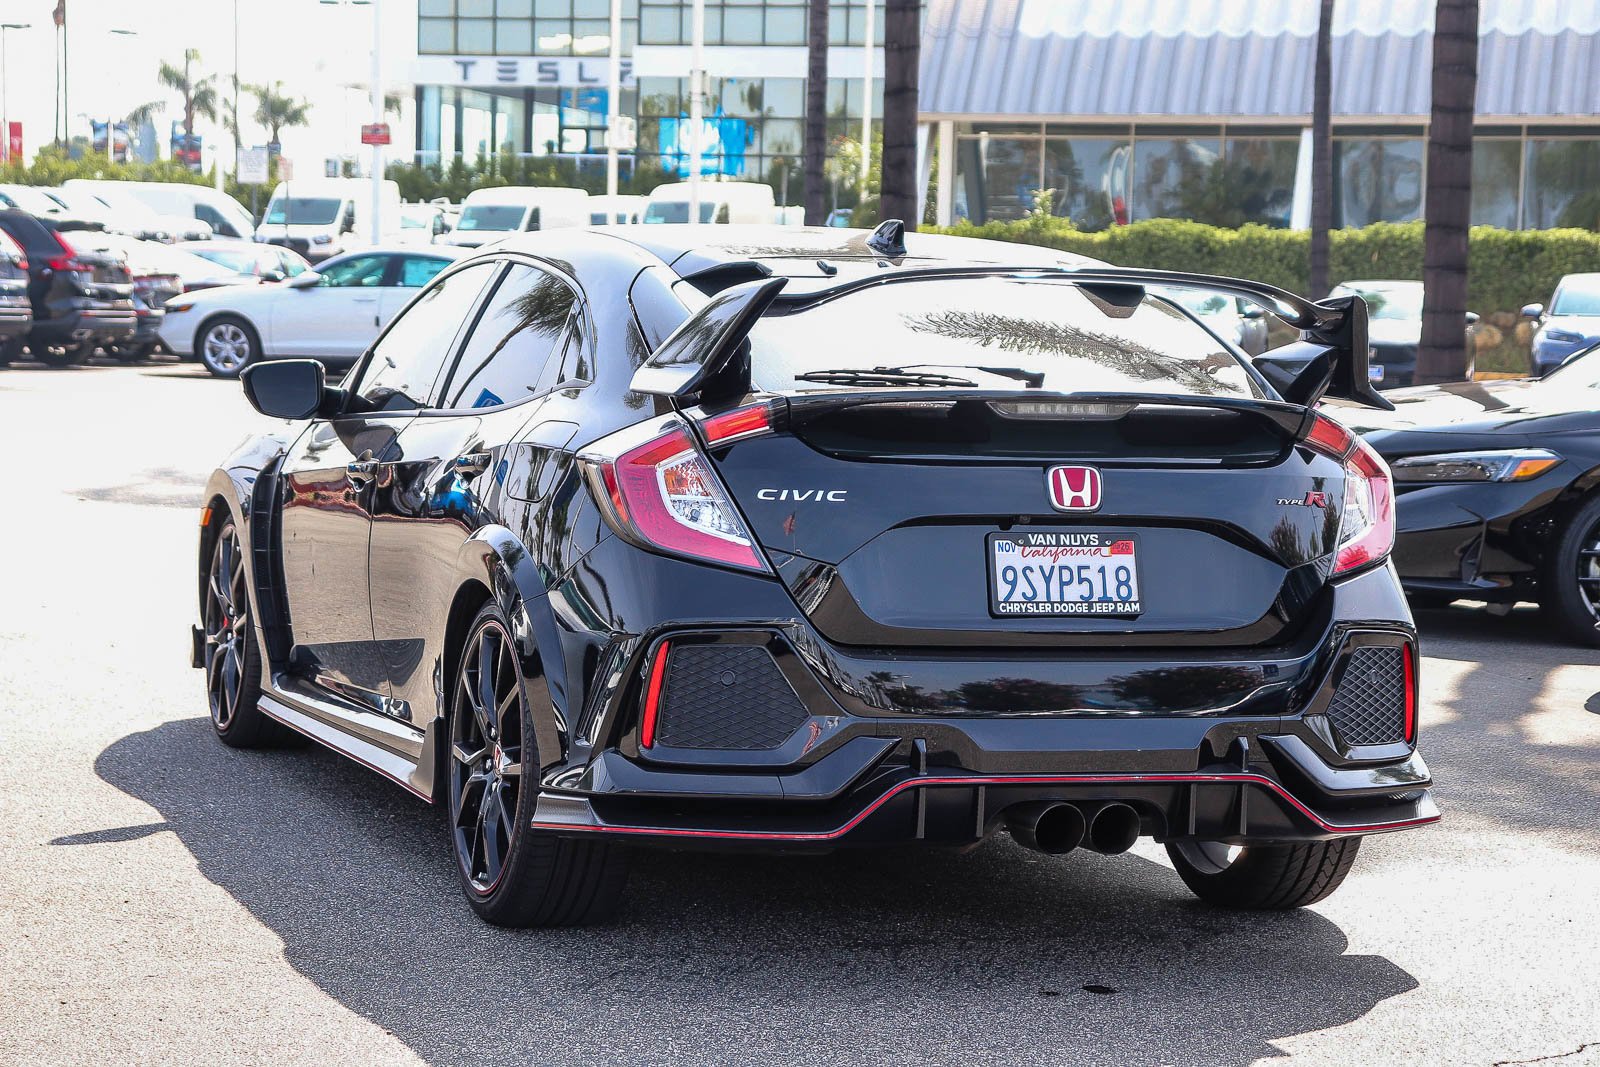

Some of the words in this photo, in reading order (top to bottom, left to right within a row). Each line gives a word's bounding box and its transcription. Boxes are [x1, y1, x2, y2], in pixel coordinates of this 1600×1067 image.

[757, 488, 847, 502] CIVIC
[1277, 498, 1305, 506] TYPE
[1305, 491, 1327, 508] R
[1028, 533, 1056, 546] VAN
[1060, 533, 1099, 546] NUYS
[997, 541, 1017, 553] NOV
[1021, 546, 1112, 564] California
[1001, 565, 1133, 602] 9SYP518
[999, 602, 1052, 613] CHRYSLER
[1054, 602, 1089, 613] DODGE
[1091, 602, 1115, 613] JEEP
[1117, 602, 1140, 613] RAM
